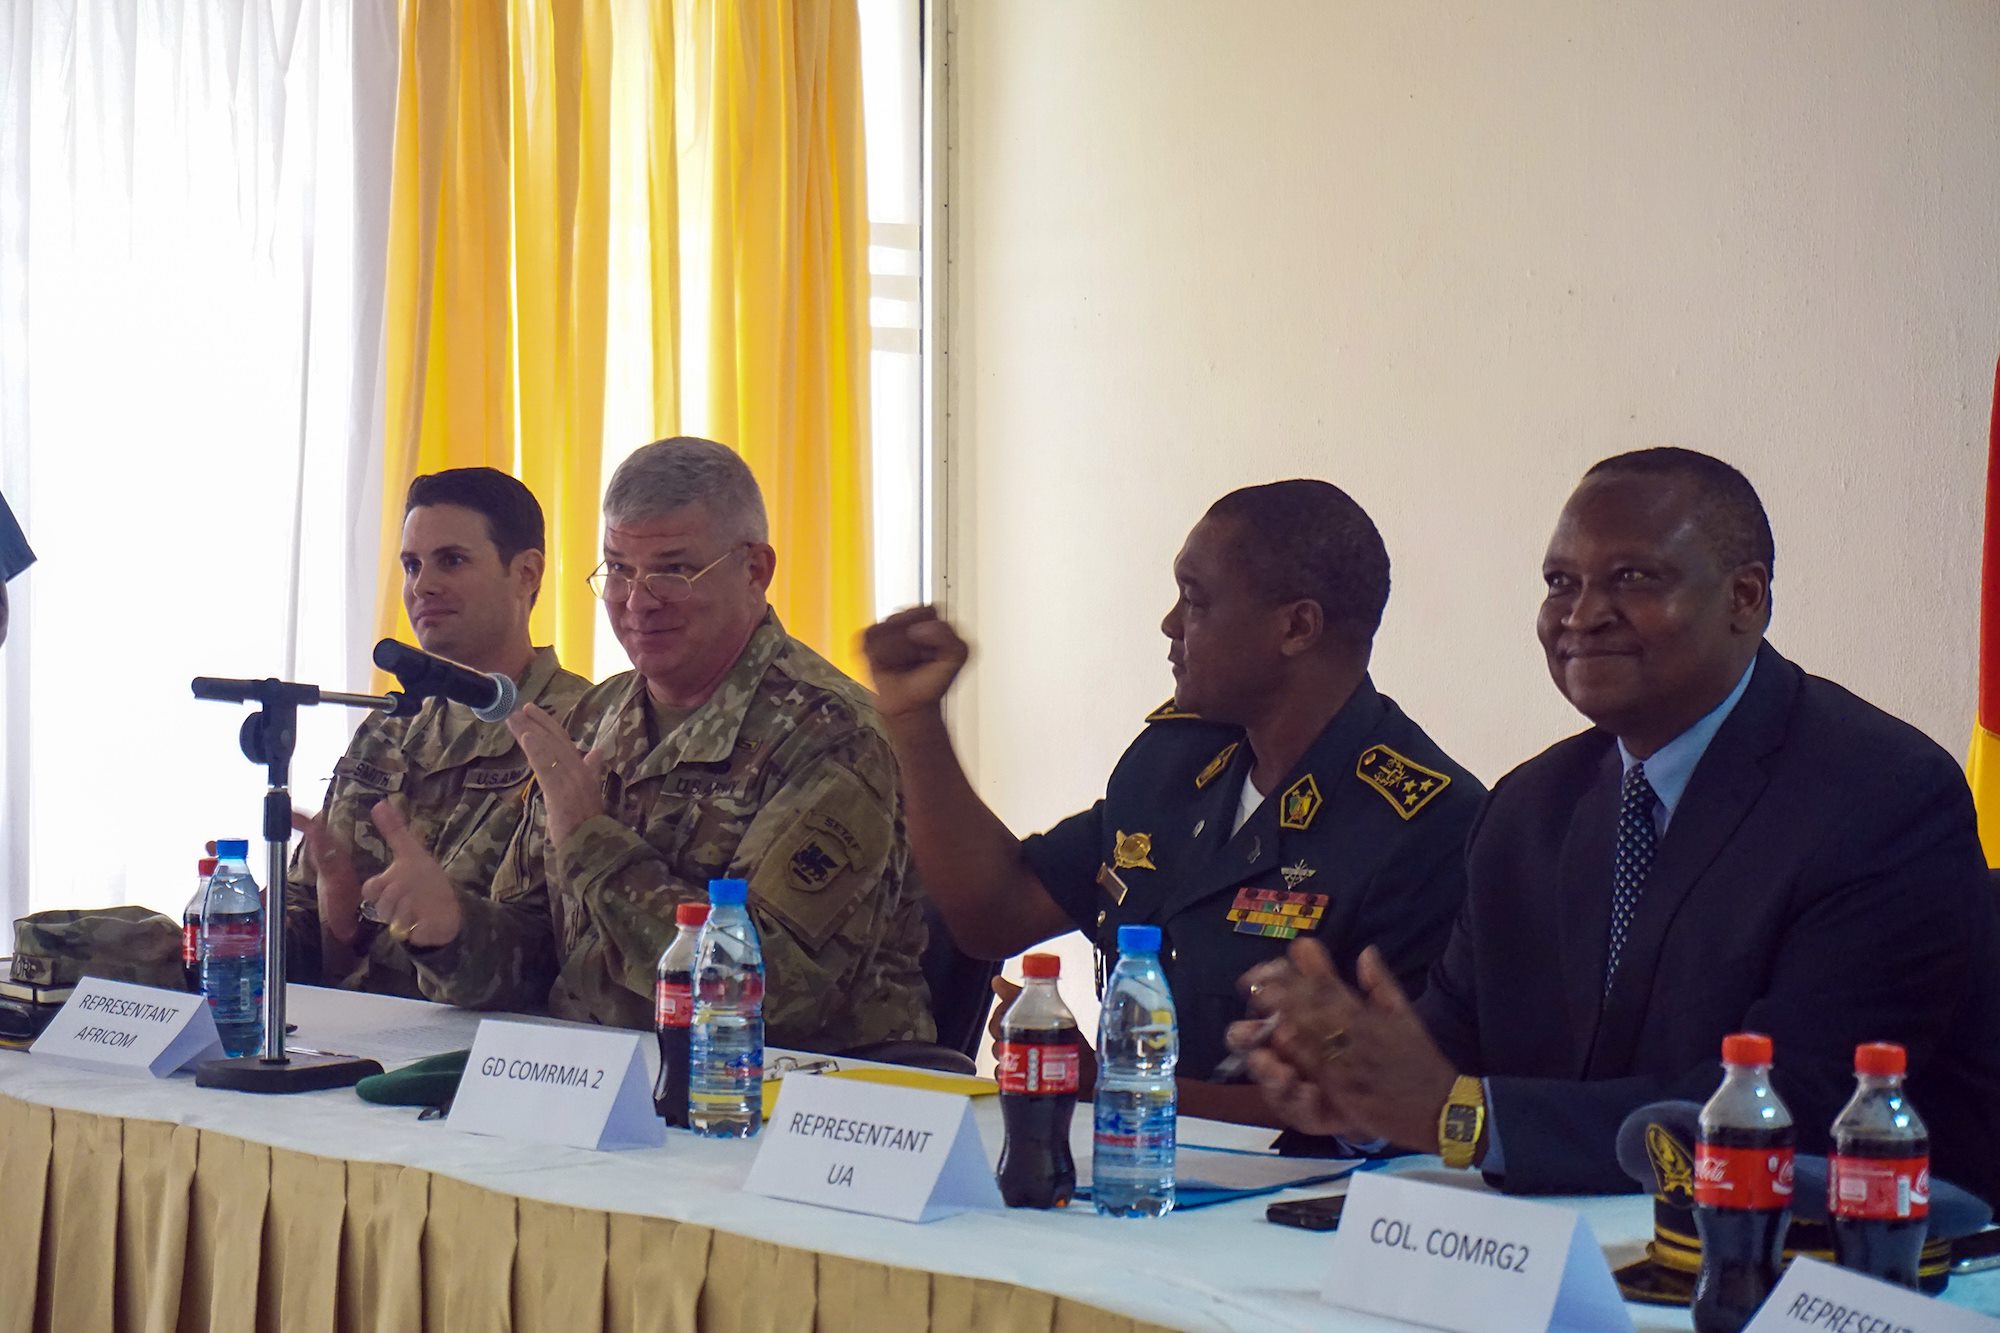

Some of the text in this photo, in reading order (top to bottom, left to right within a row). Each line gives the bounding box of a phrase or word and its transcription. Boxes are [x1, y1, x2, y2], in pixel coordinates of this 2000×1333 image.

[353, 762, 391, 786] SMITH
[78, 993, 179, 1024] REPRESENTANT
[73, 1026, 138, 1048] AFRICOM
[482, 1057, 605, 1089] GD COMRMIA 2
[789, 1112, 934, 1152] REPRESENTANT
[827, 1163, 855, 1187] UA
[1370, 1217, 1530, 1274] COL. COMRG2
[1786, 1292, 1914, 1333] REPRESE
